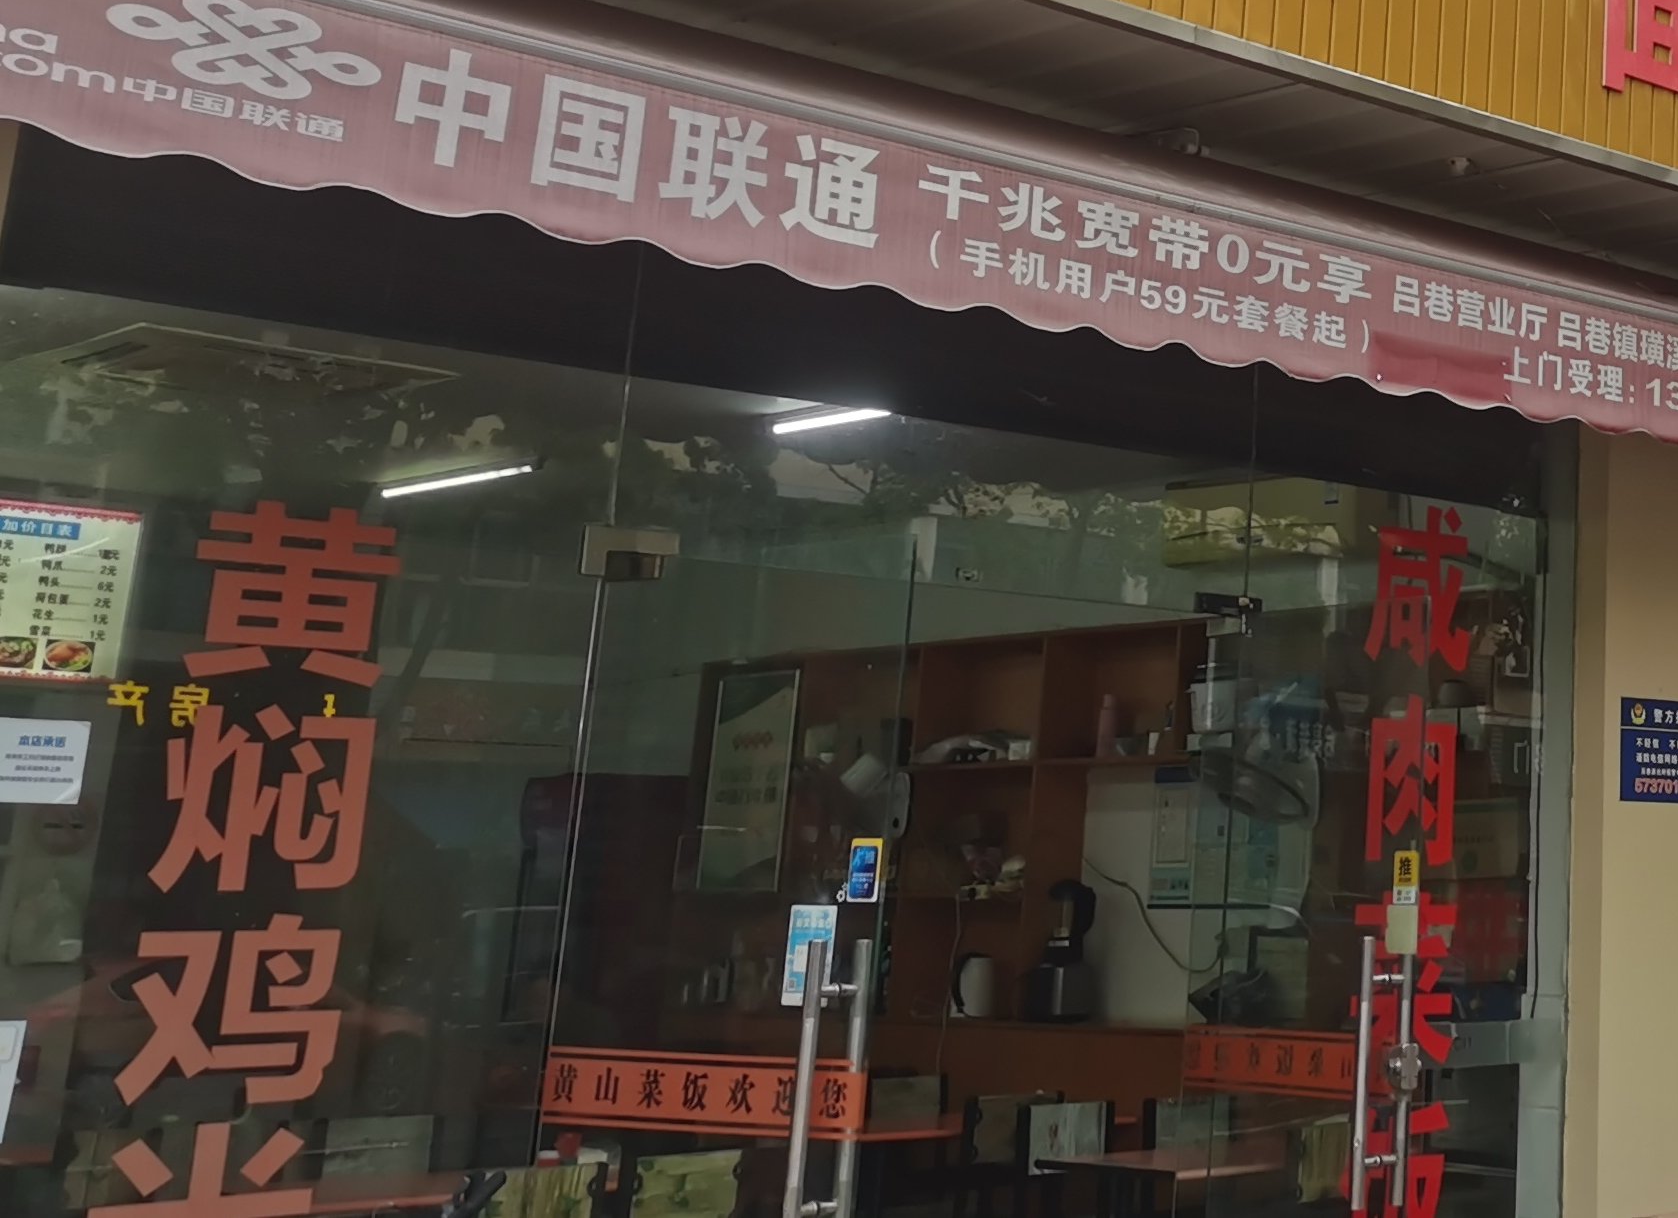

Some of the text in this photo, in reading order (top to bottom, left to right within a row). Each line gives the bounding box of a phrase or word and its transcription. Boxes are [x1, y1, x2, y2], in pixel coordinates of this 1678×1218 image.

[0, 23, 57, 54] a
[0, 52, 115, 93] om
[122, 76, 344, 142] 中国联通
[395, 49, 880, 248] 中国联通
[918, 164, 1372, 305] 千兆宽带0元享
